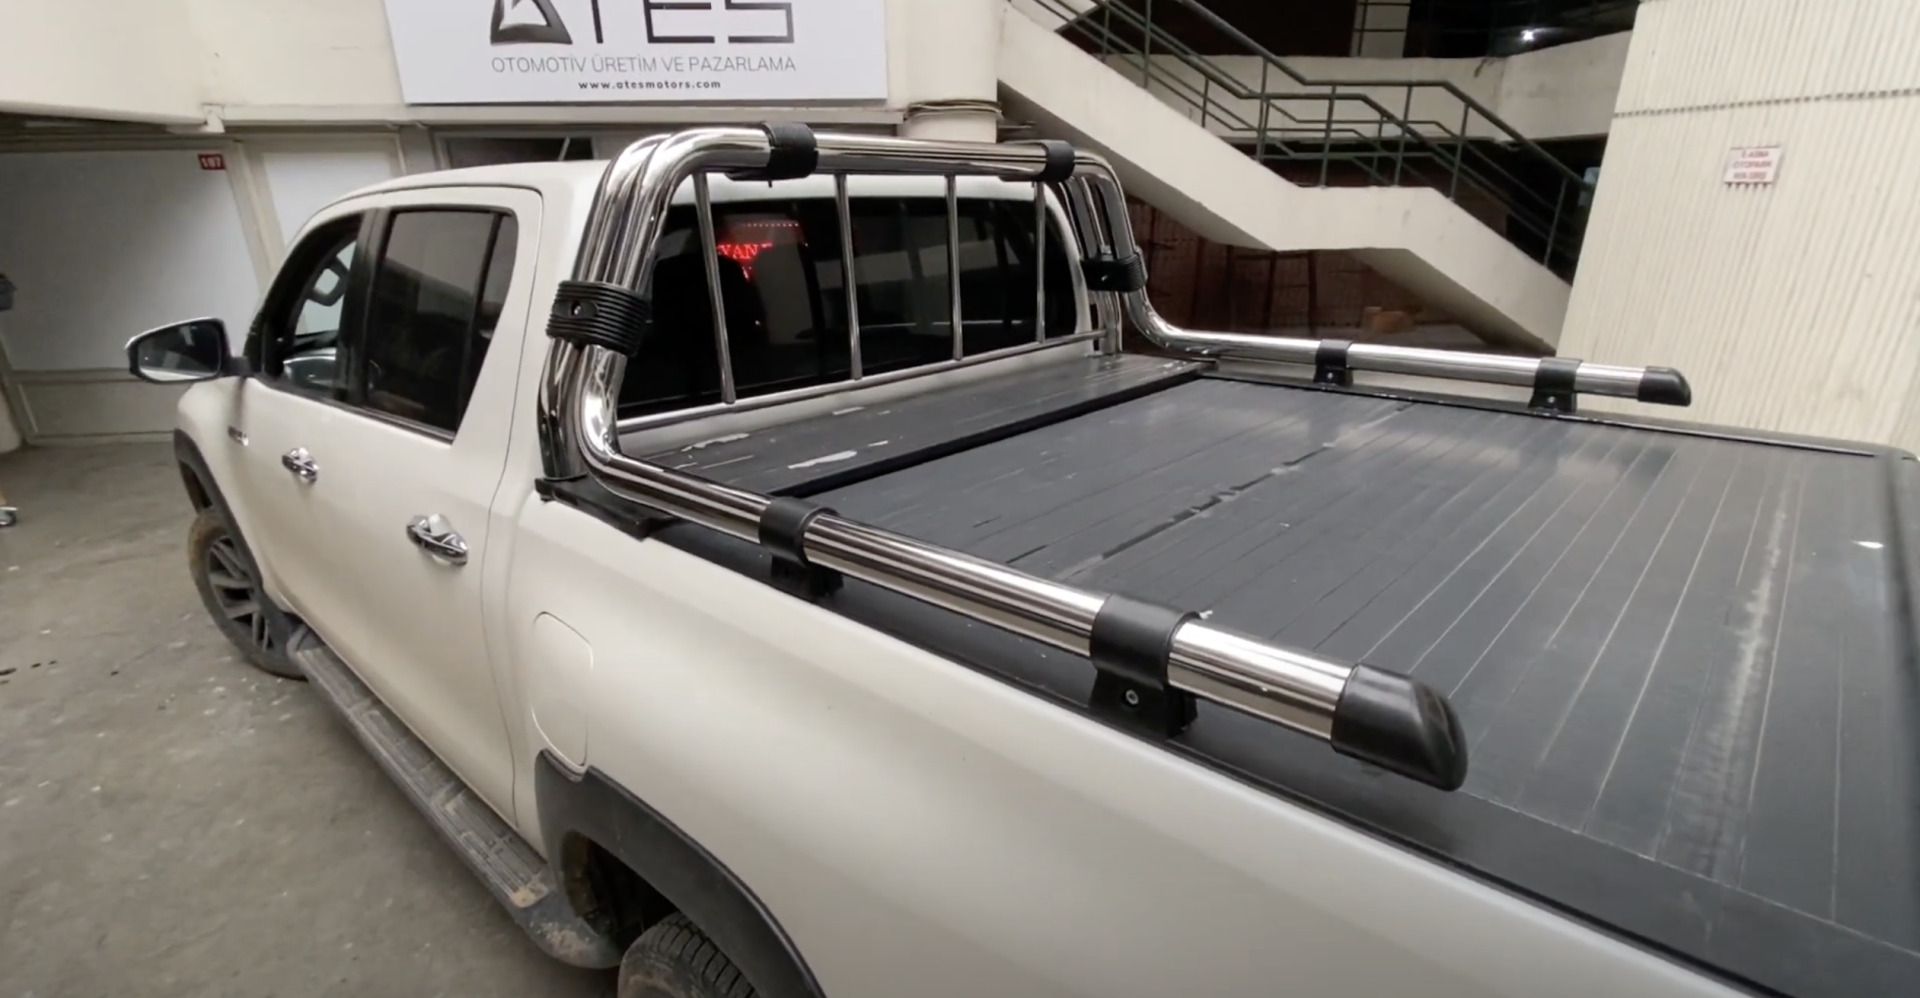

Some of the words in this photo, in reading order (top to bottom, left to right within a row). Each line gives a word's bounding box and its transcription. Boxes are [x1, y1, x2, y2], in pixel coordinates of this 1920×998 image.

[491, 54, 587, 73] OTOMOTİV
[591, 54, 658, 73] ÜRETİM
[661, 56, 685, 72] VE
[688, 56, 796, 72] PAZARLAMA
[578, 80, 721, 90] www.atesmotors.com
